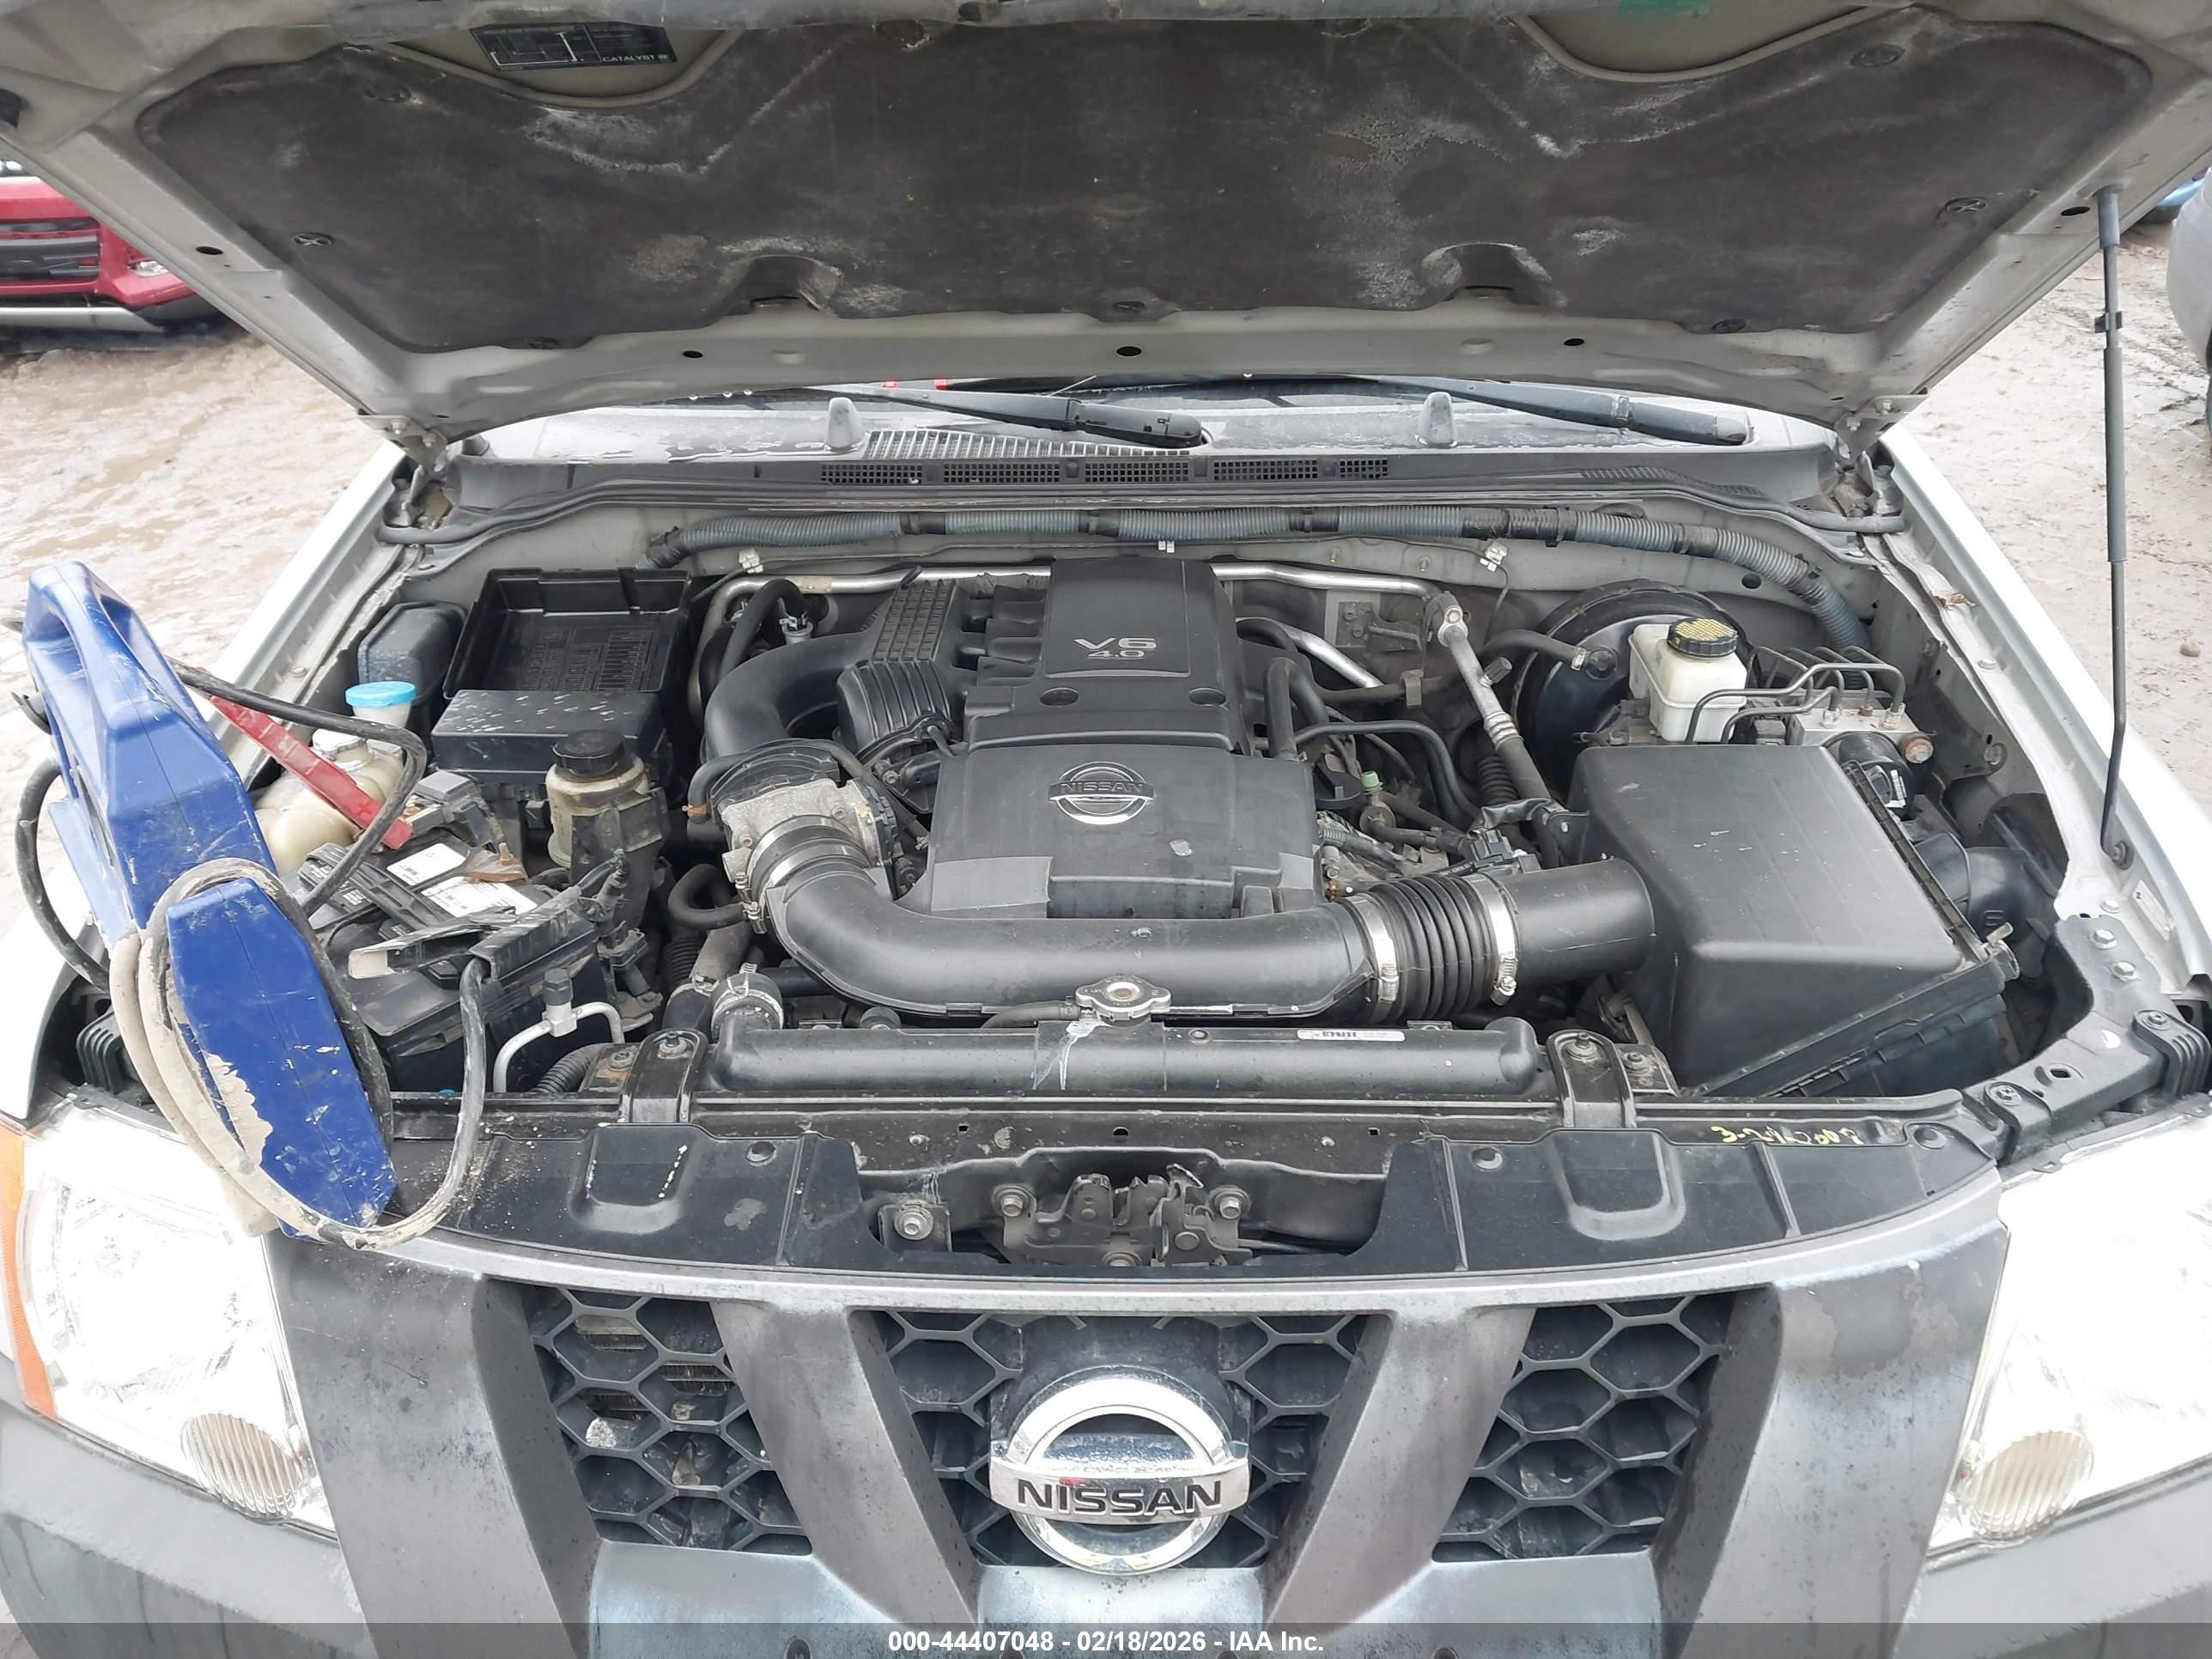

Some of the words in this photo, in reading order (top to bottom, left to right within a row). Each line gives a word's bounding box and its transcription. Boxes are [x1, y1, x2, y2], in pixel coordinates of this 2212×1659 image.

[602, 53, 655, 63] CATALYST
[1073, 638, 1157, 649] V6
[1087, 649, 1146, 659] 4.0
[1060, 781, 1144, 793] NISSAN
[1017, 1478, 1222, 1516] NISSAN
